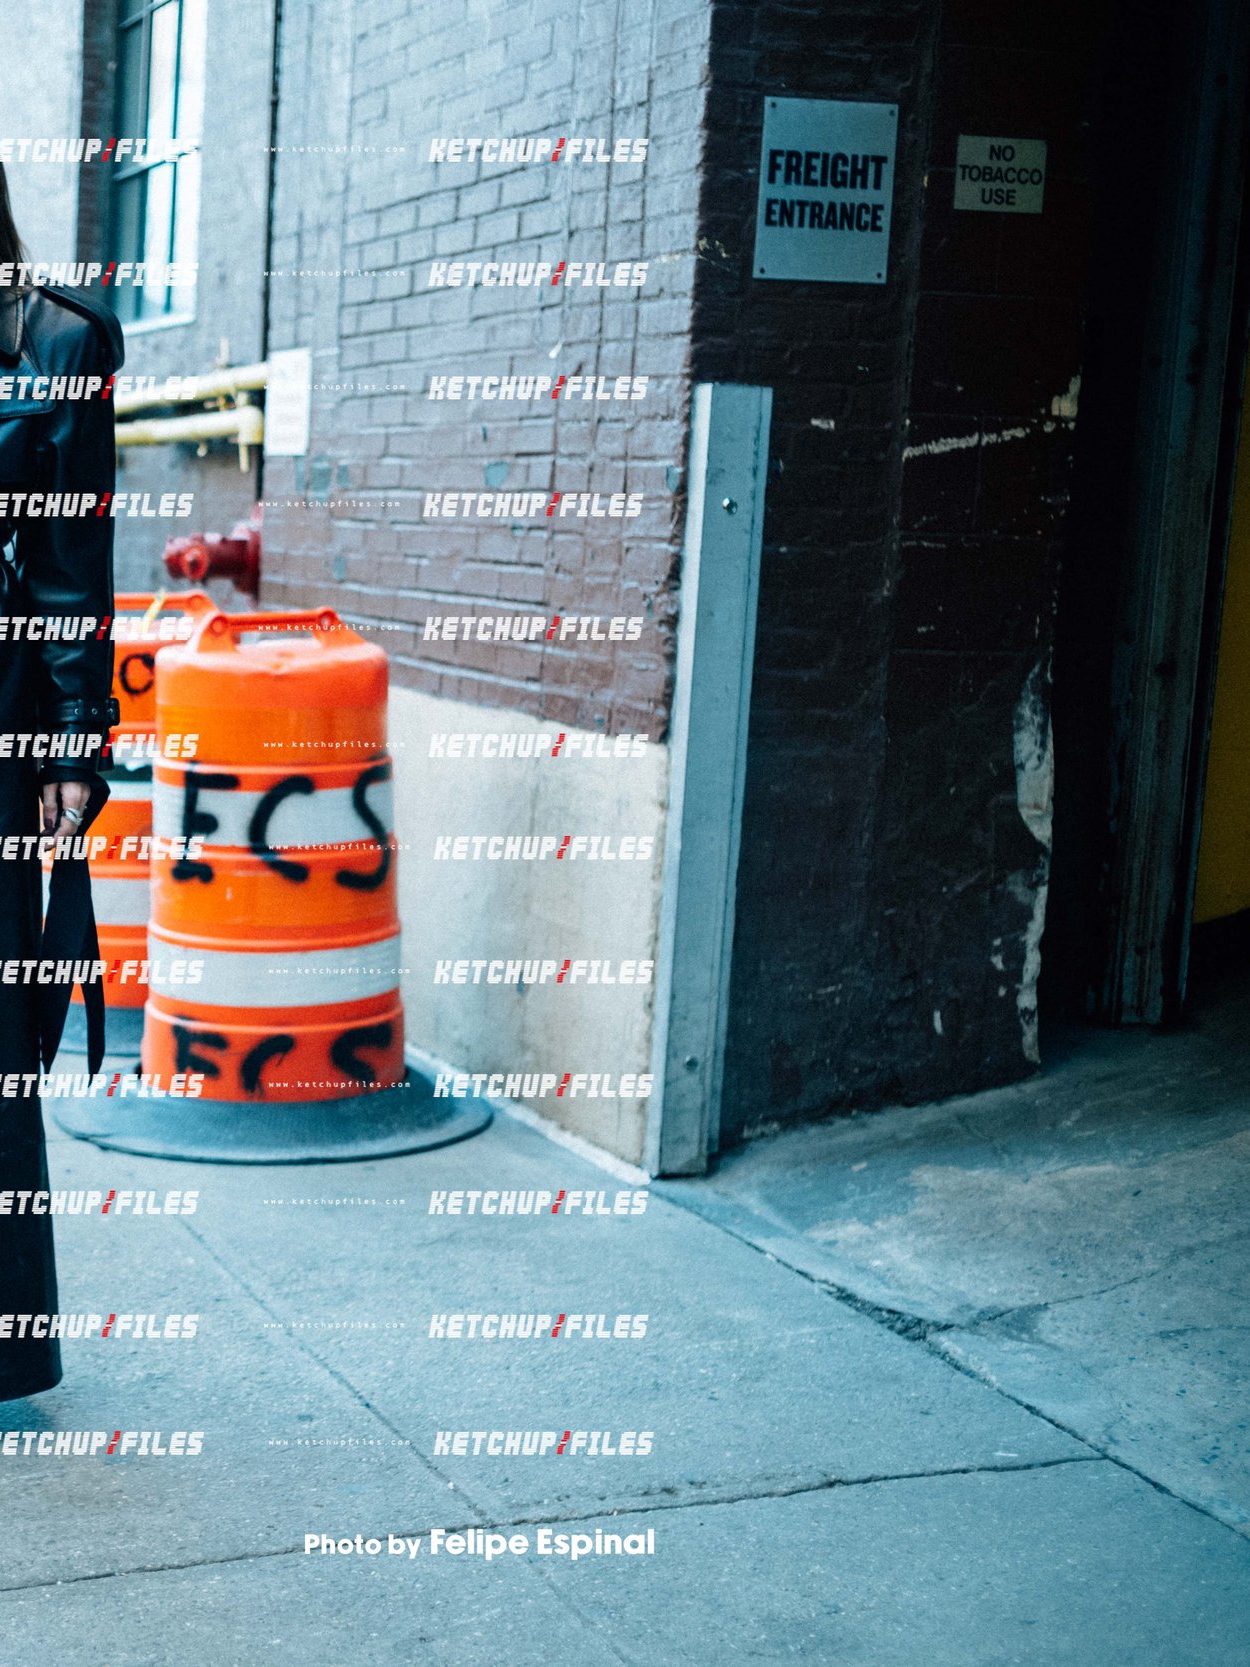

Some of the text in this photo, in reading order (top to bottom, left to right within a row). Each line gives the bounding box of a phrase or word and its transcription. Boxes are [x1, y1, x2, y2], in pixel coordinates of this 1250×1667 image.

[988, 144, 1016, 163] NO
[766, 149, 888, 191] FREIGHT
[959, 163, 1043, 187] TOBACCO
[980, 187, 1017, 207] USE
[764, 198, 884, 233] ENTRANCE
